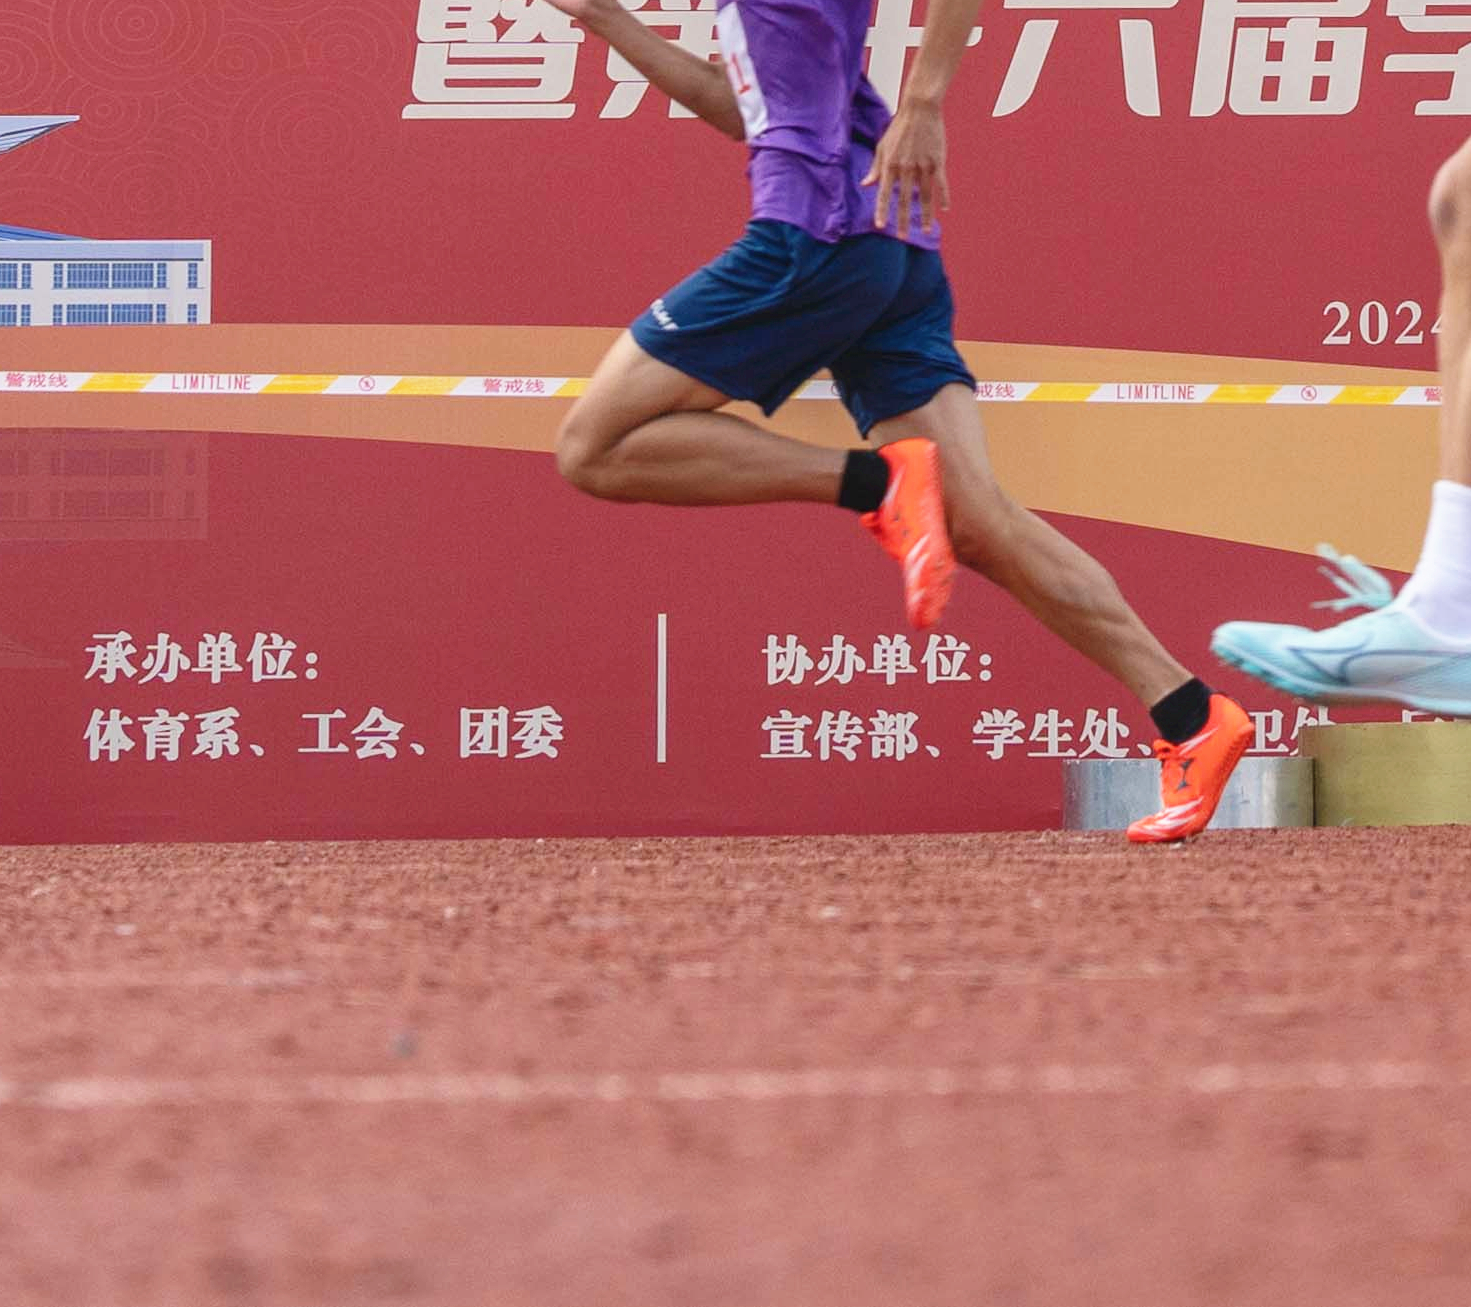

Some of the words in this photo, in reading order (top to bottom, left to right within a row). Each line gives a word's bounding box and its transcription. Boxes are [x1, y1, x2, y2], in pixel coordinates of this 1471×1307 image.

[170, 372, 253, 391] LIMITLINE
[1115, 383, 1196, 402] LIMITLINE
[83, 704, 566, 762] 体育系、工会、团委
